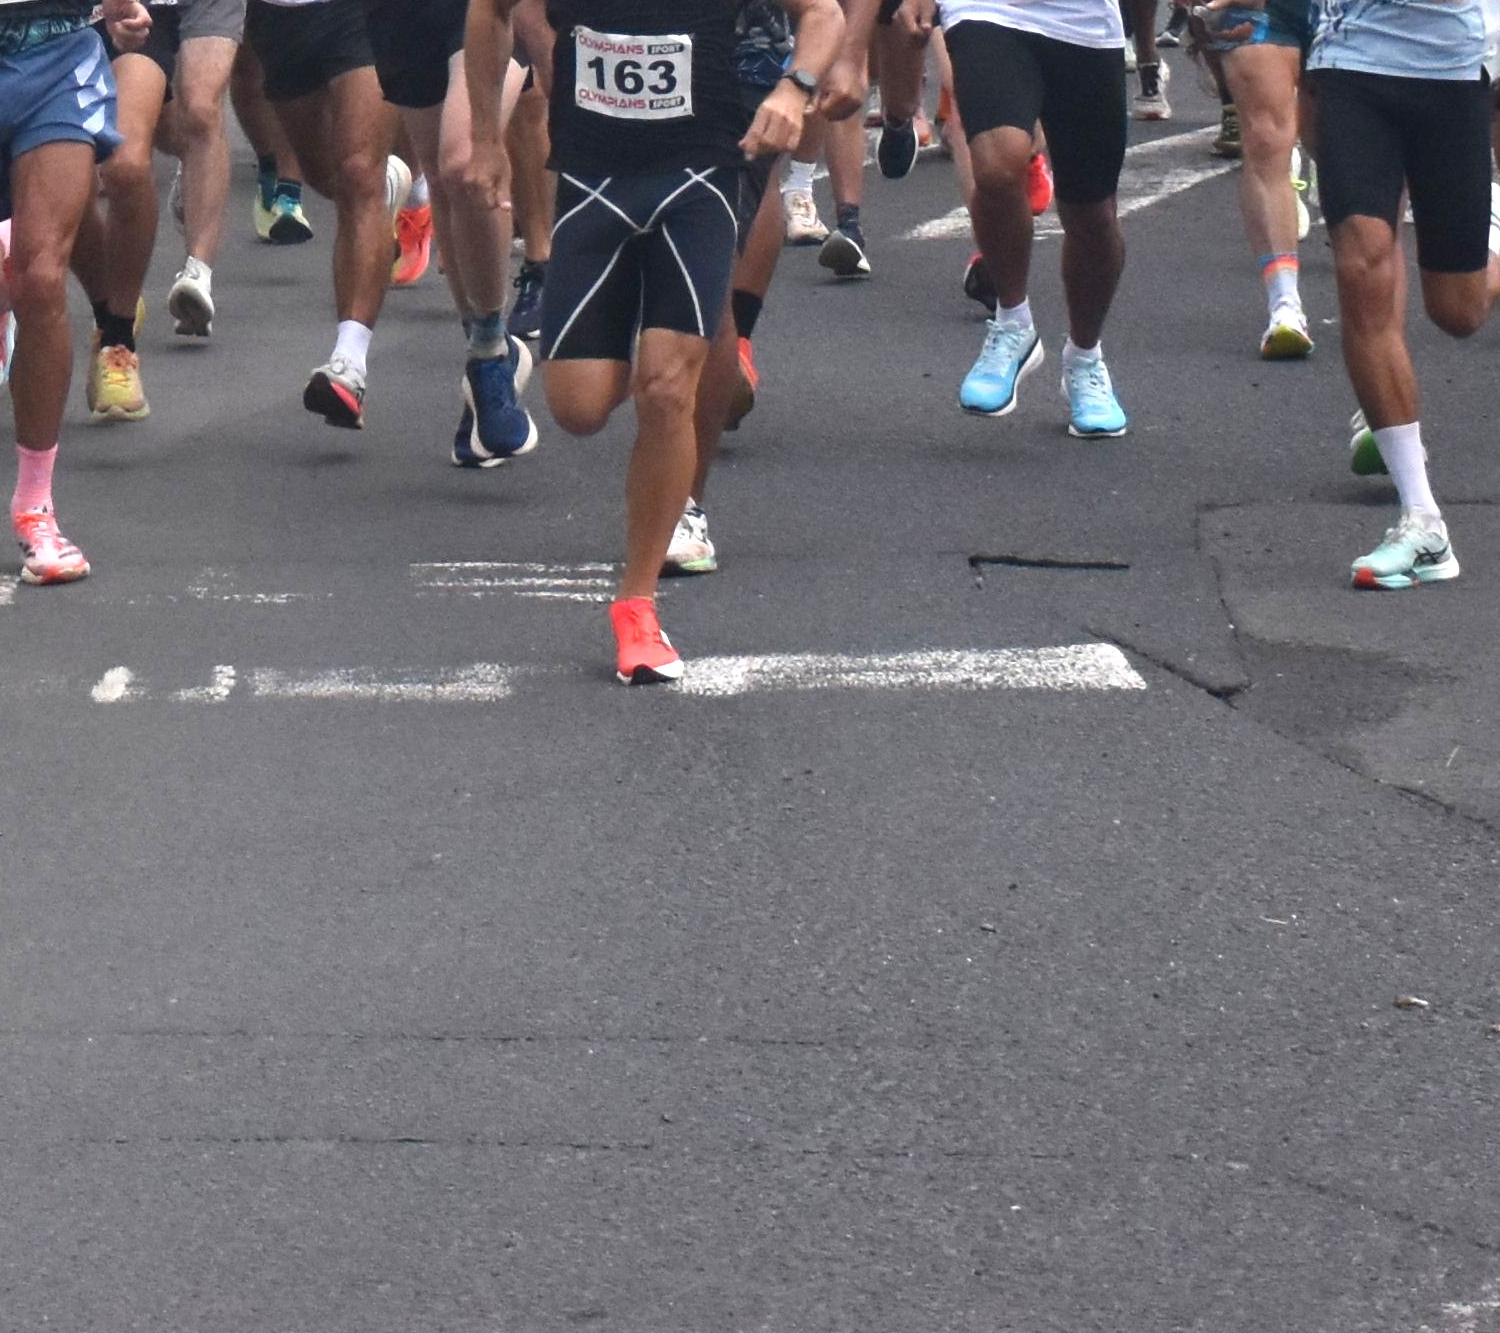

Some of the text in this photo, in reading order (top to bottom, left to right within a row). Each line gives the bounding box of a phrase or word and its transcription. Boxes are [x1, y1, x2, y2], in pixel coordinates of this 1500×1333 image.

[578, 34, 682, 55] OLYMPIANS SPORT
[587, 56, 677, 95] 163
[578, 88, 682, 110] OLYMPIANS SPORT
